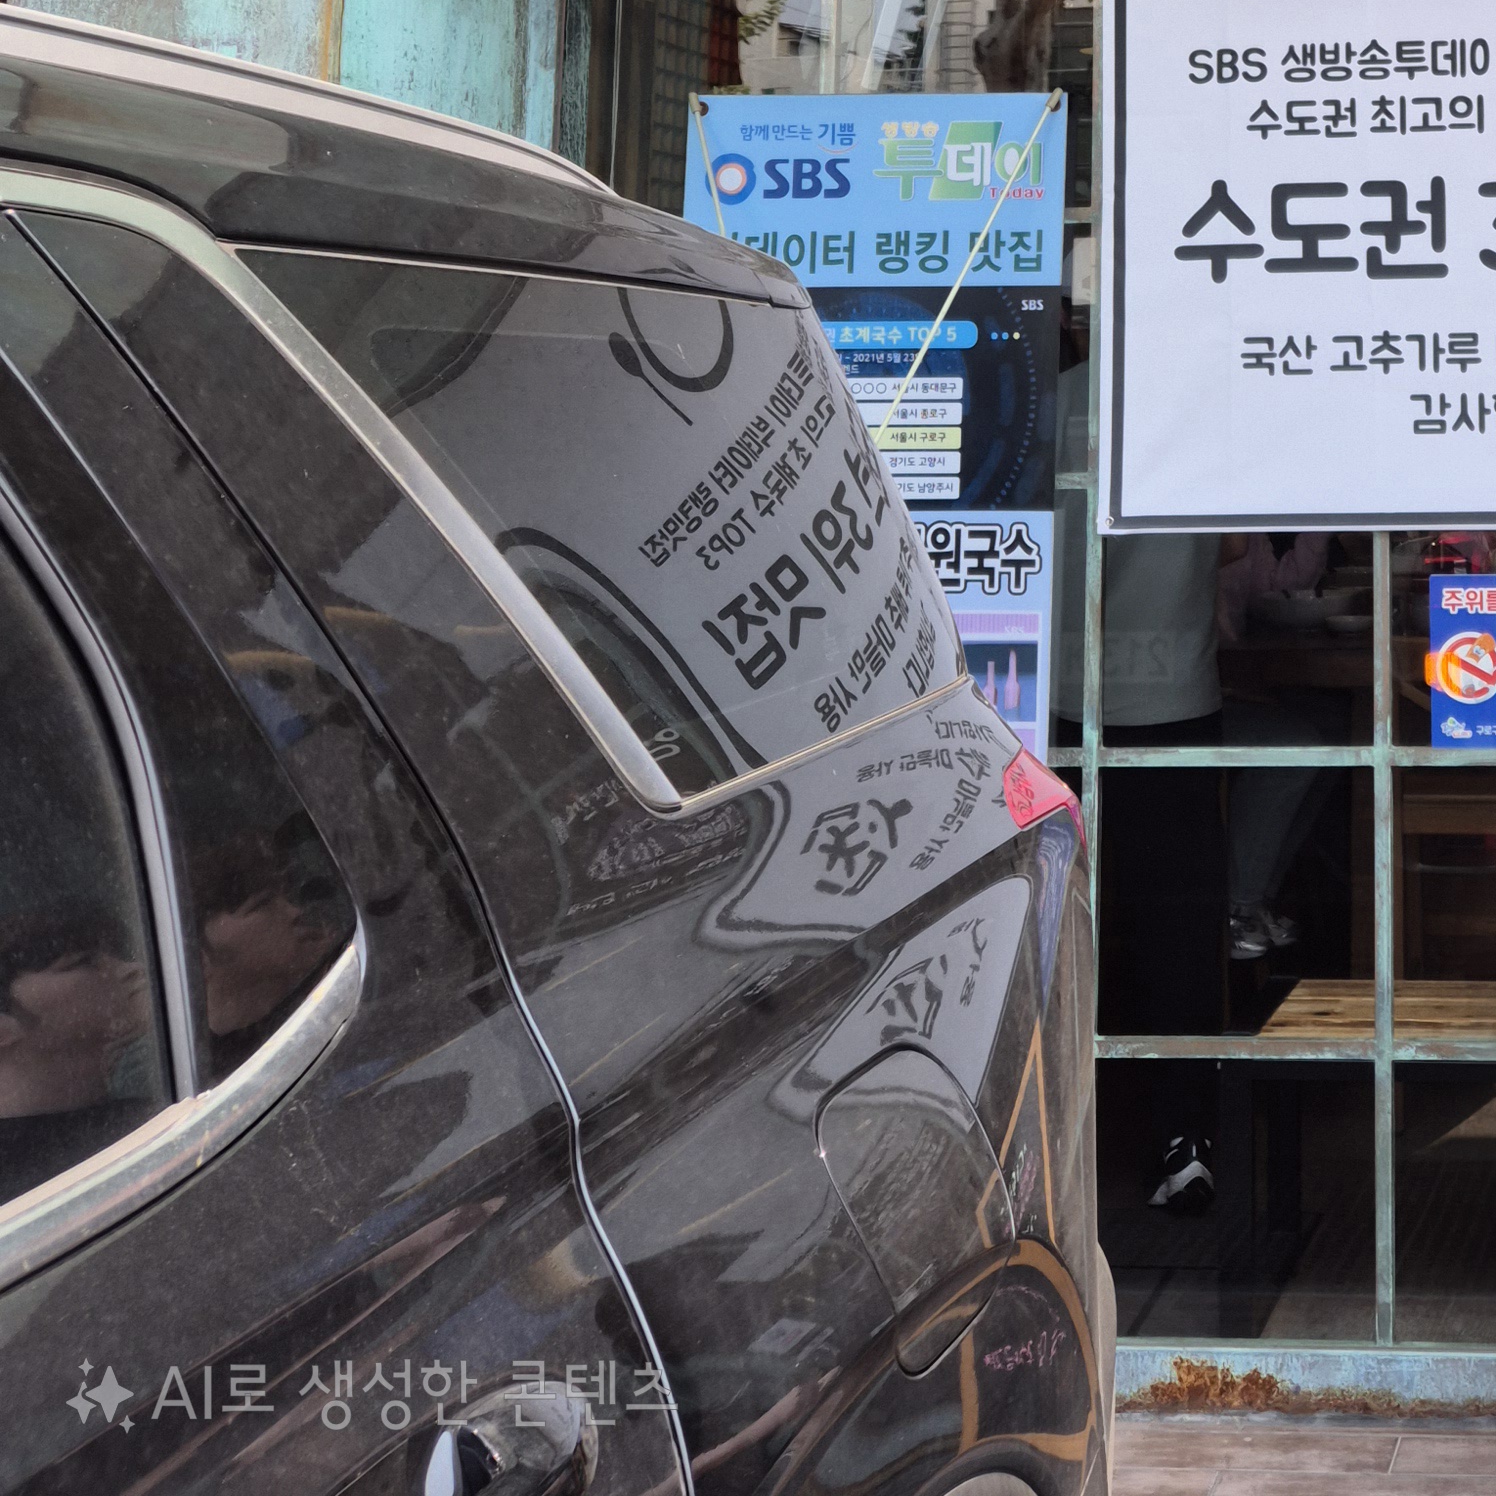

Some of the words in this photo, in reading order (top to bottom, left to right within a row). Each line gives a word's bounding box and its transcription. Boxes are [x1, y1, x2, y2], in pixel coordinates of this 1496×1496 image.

[1188, 48, 1268, 84] SBS
[1247, 97, 1357, 139] 수도권
[1370, 94, 1485, 134] 최고의
[763, 158, 851, 199] SBS
[872, 138, 1044, 201] 투데이
[989, 187, 1045, 200] Today
[1175, 176, 1449, 283] 수도권
[875, 231, 949, 275] 랭킹
[968, 229, 1043, 274] 맛집
[1021, 299, 1044, 311] SBS
[839, 326, 902, 344] 초계국수
[1241, 334, 1317, 375] 국산
[1330, 330, 1482, 374] 고추가루
[890, 432, 917, 443] 서울시
[888, 457, 916, 468] 경기도
